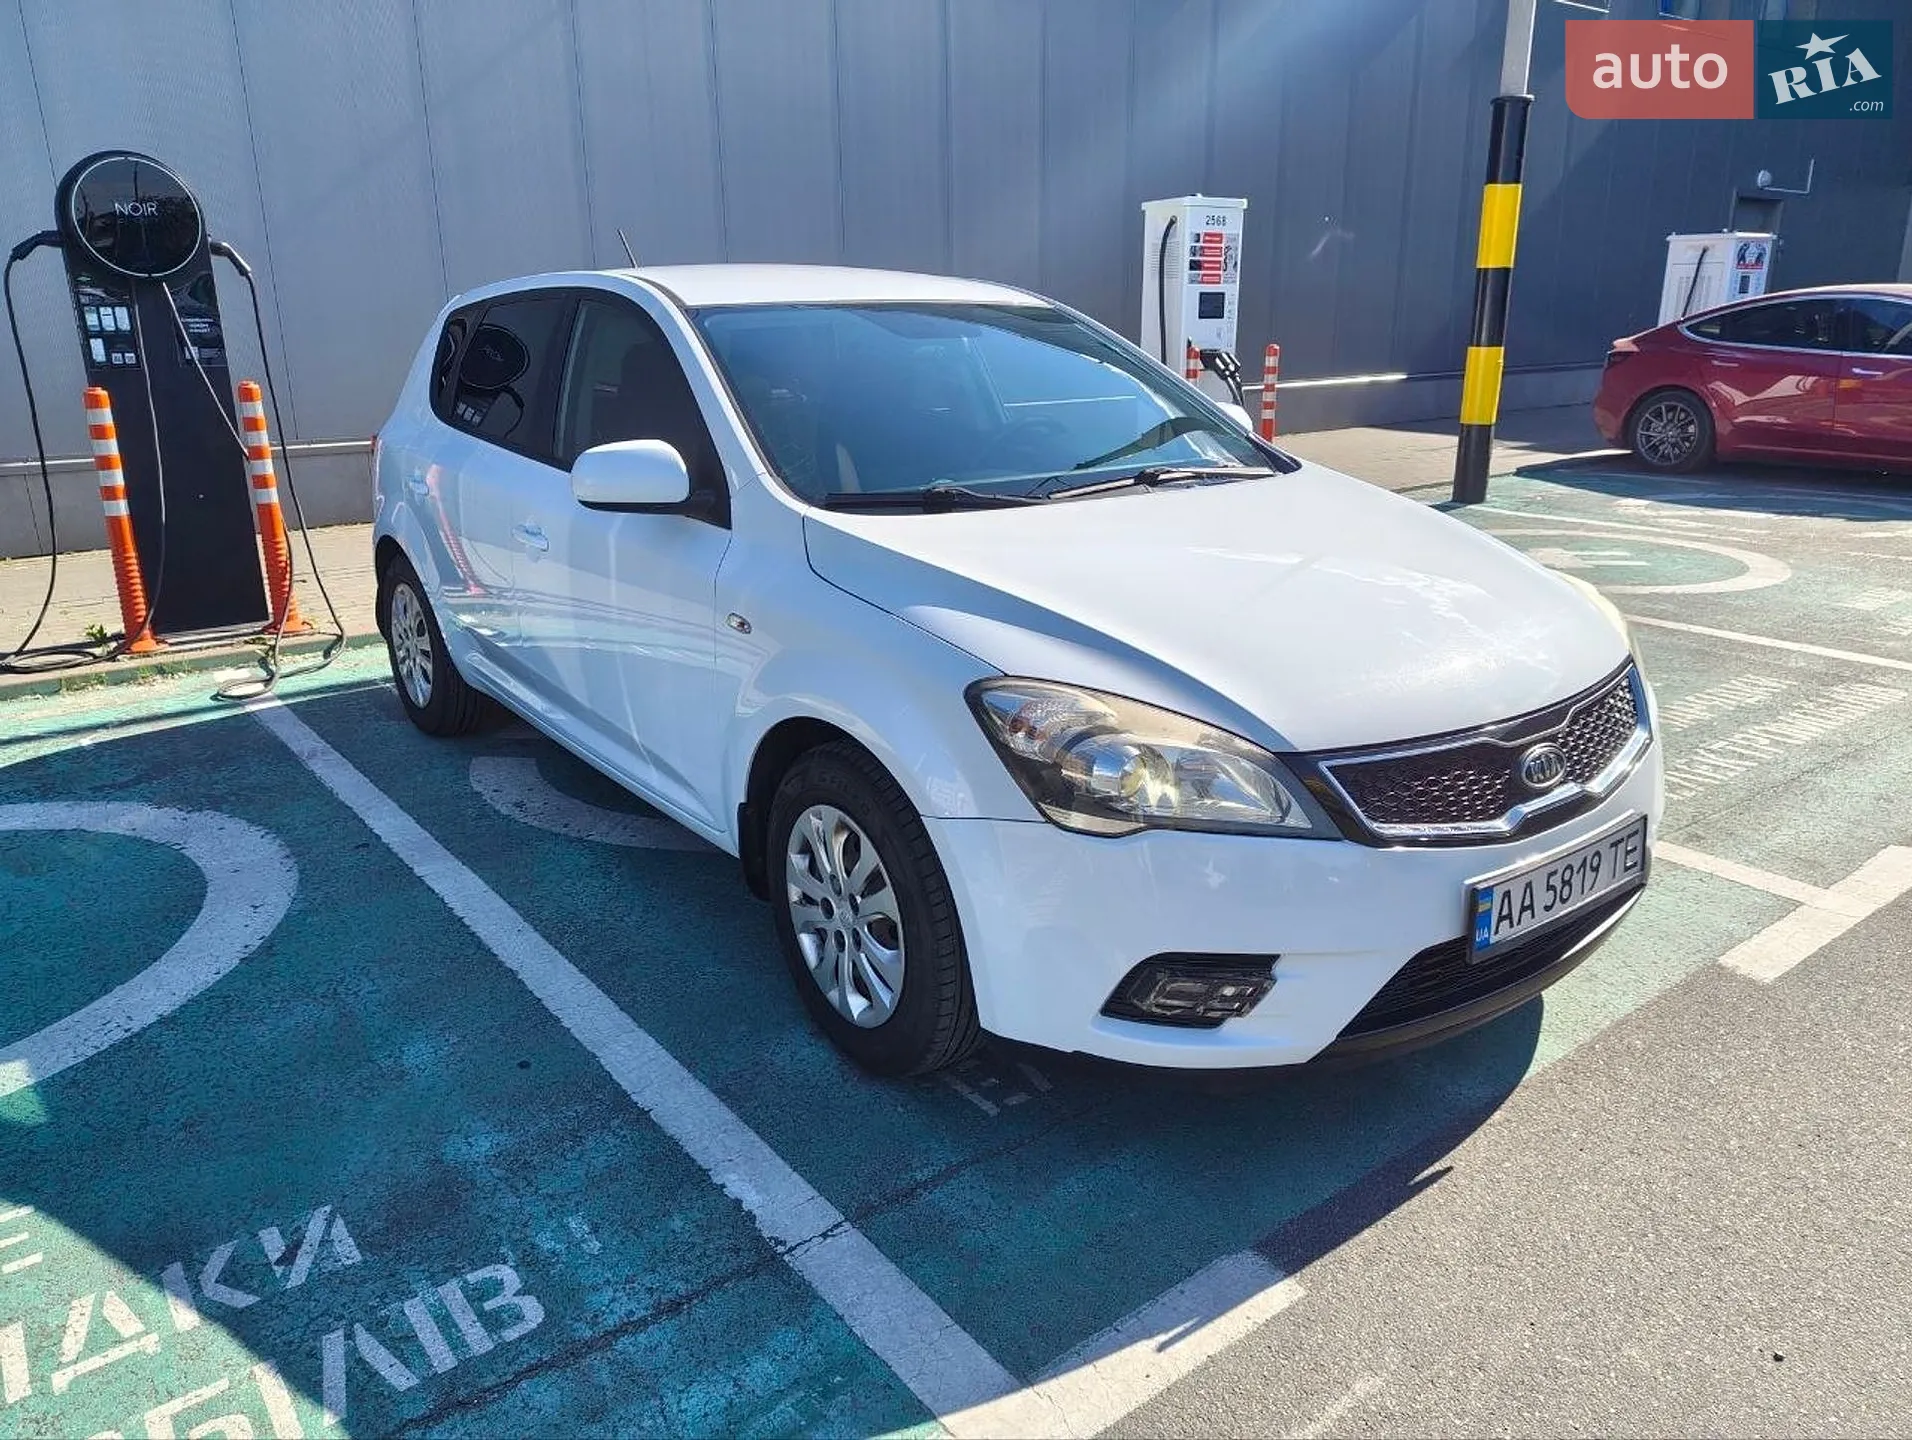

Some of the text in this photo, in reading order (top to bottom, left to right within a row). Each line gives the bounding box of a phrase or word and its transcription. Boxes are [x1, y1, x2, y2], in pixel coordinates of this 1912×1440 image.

[114, 201, 158, 216] NOIR
[1494, 829, 1640, 936] AA 5819 TE
[1475, 926, 1489, 942] UA
